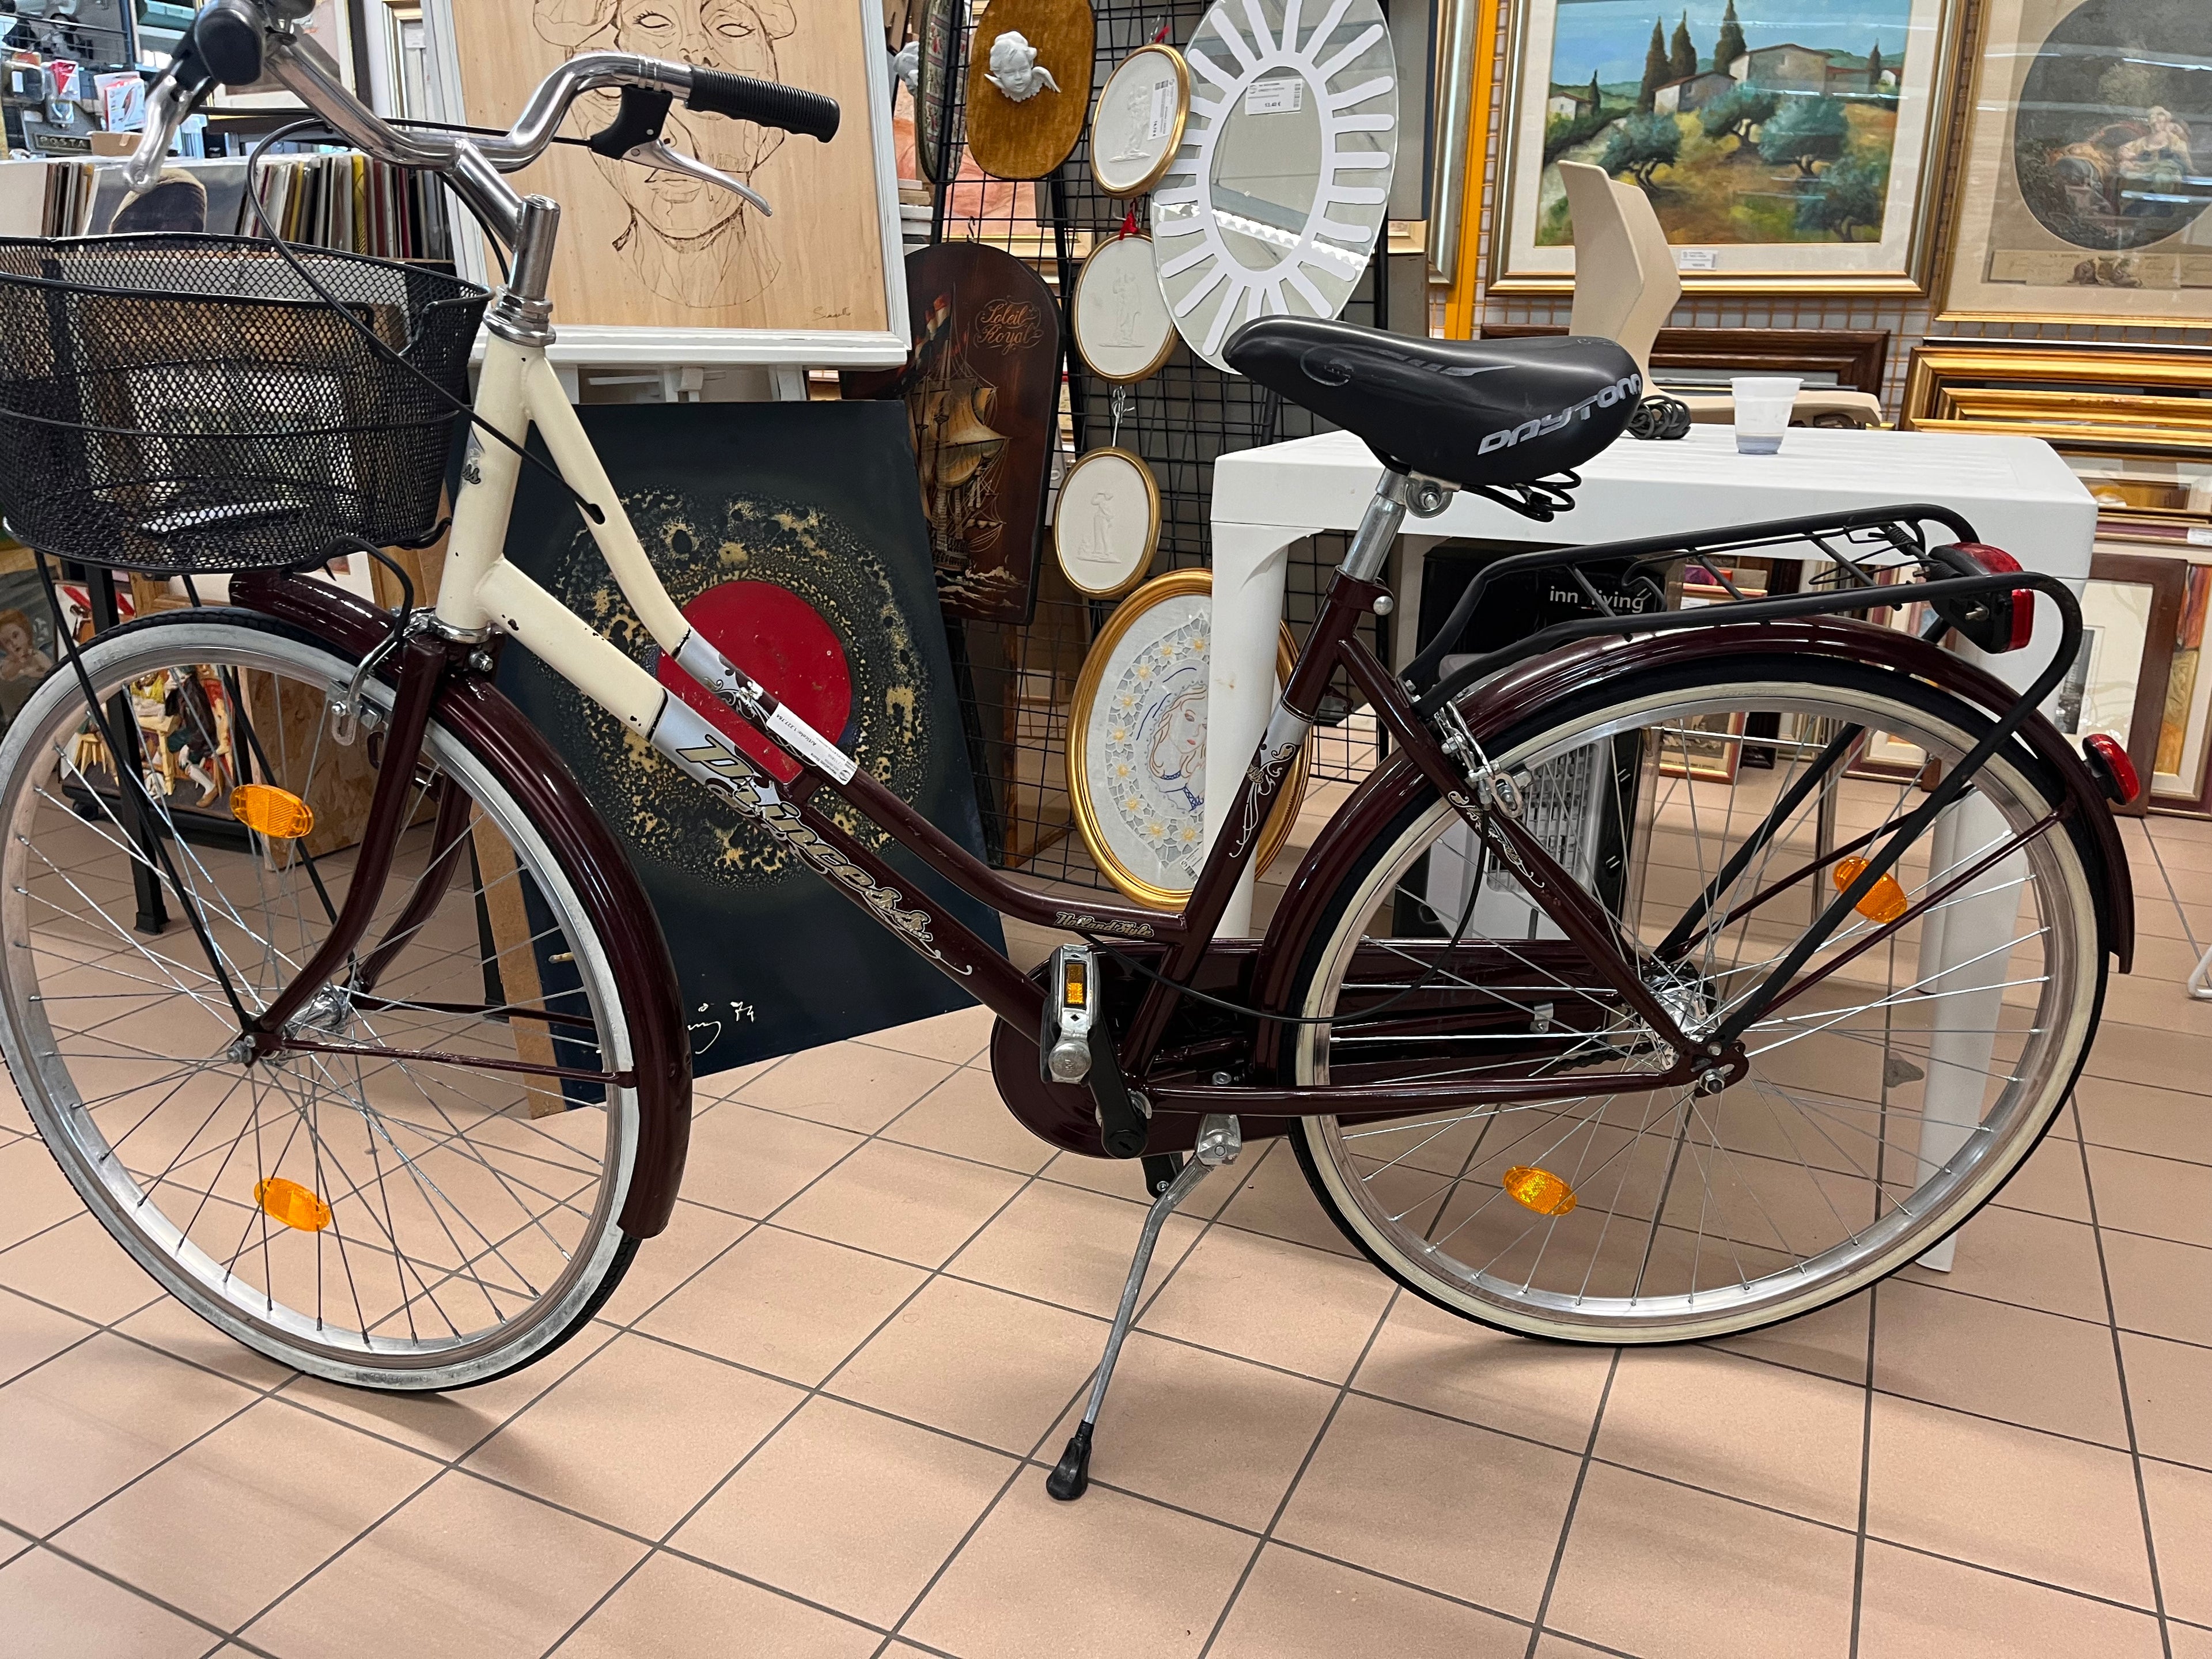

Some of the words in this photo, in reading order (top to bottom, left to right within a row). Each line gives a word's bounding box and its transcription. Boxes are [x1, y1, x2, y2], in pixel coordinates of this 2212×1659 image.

[39, 136, 86, 147] POSTA
[980, 303, 1036, 325] Soleil
[978, 324, 1039, 355] Royal
[676, 734, 933, 942] Princess
[1056, 912, 1115, 931] Holland
[1115, 922, 1153, 937] Style
